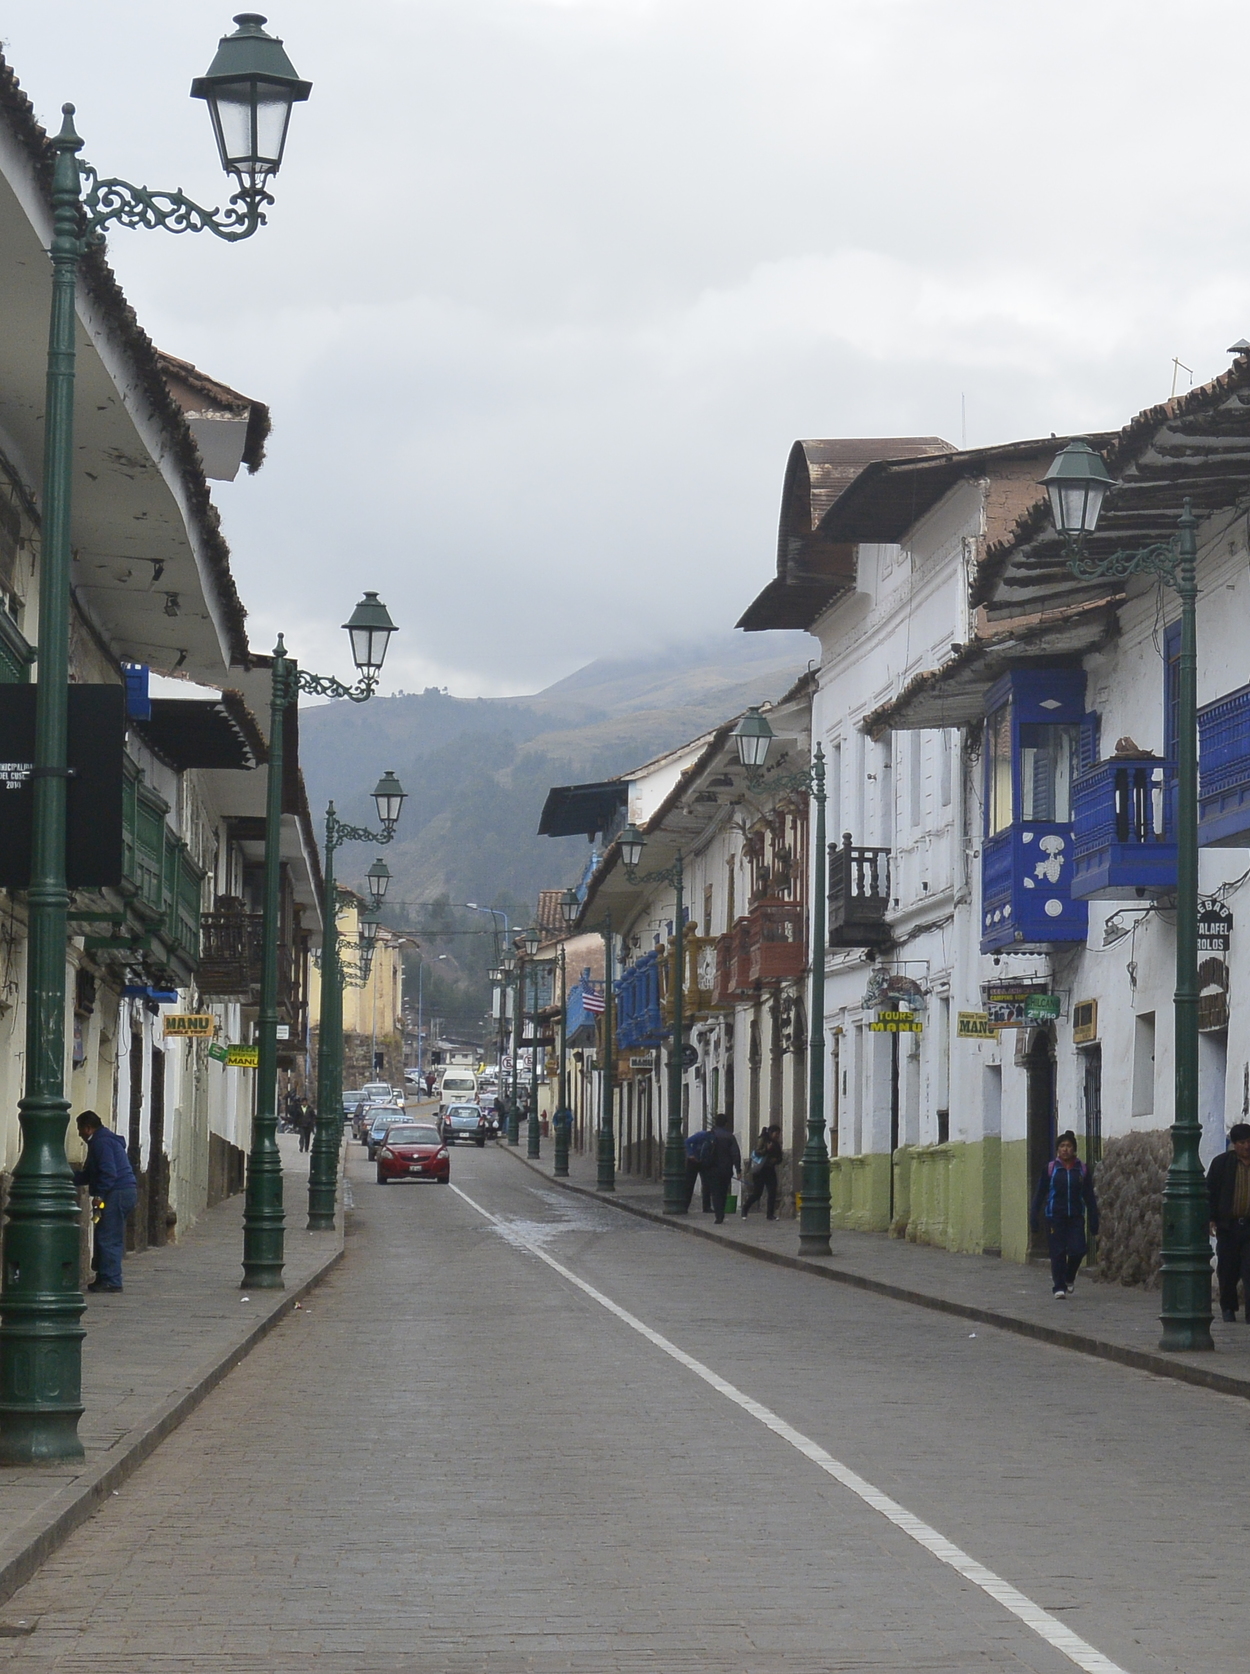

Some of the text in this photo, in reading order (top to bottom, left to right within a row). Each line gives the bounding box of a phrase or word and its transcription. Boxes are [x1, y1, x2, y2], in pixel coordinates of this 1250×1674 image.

[880, 1011, 914, 1021] TOURS
[1040, 1010, 1057, 1019] Piso
[166, 1017, 210, 1029] MANU
[870, 1022, 922, 1032] MANU
[228, 1058, 258, 1066] MANU
